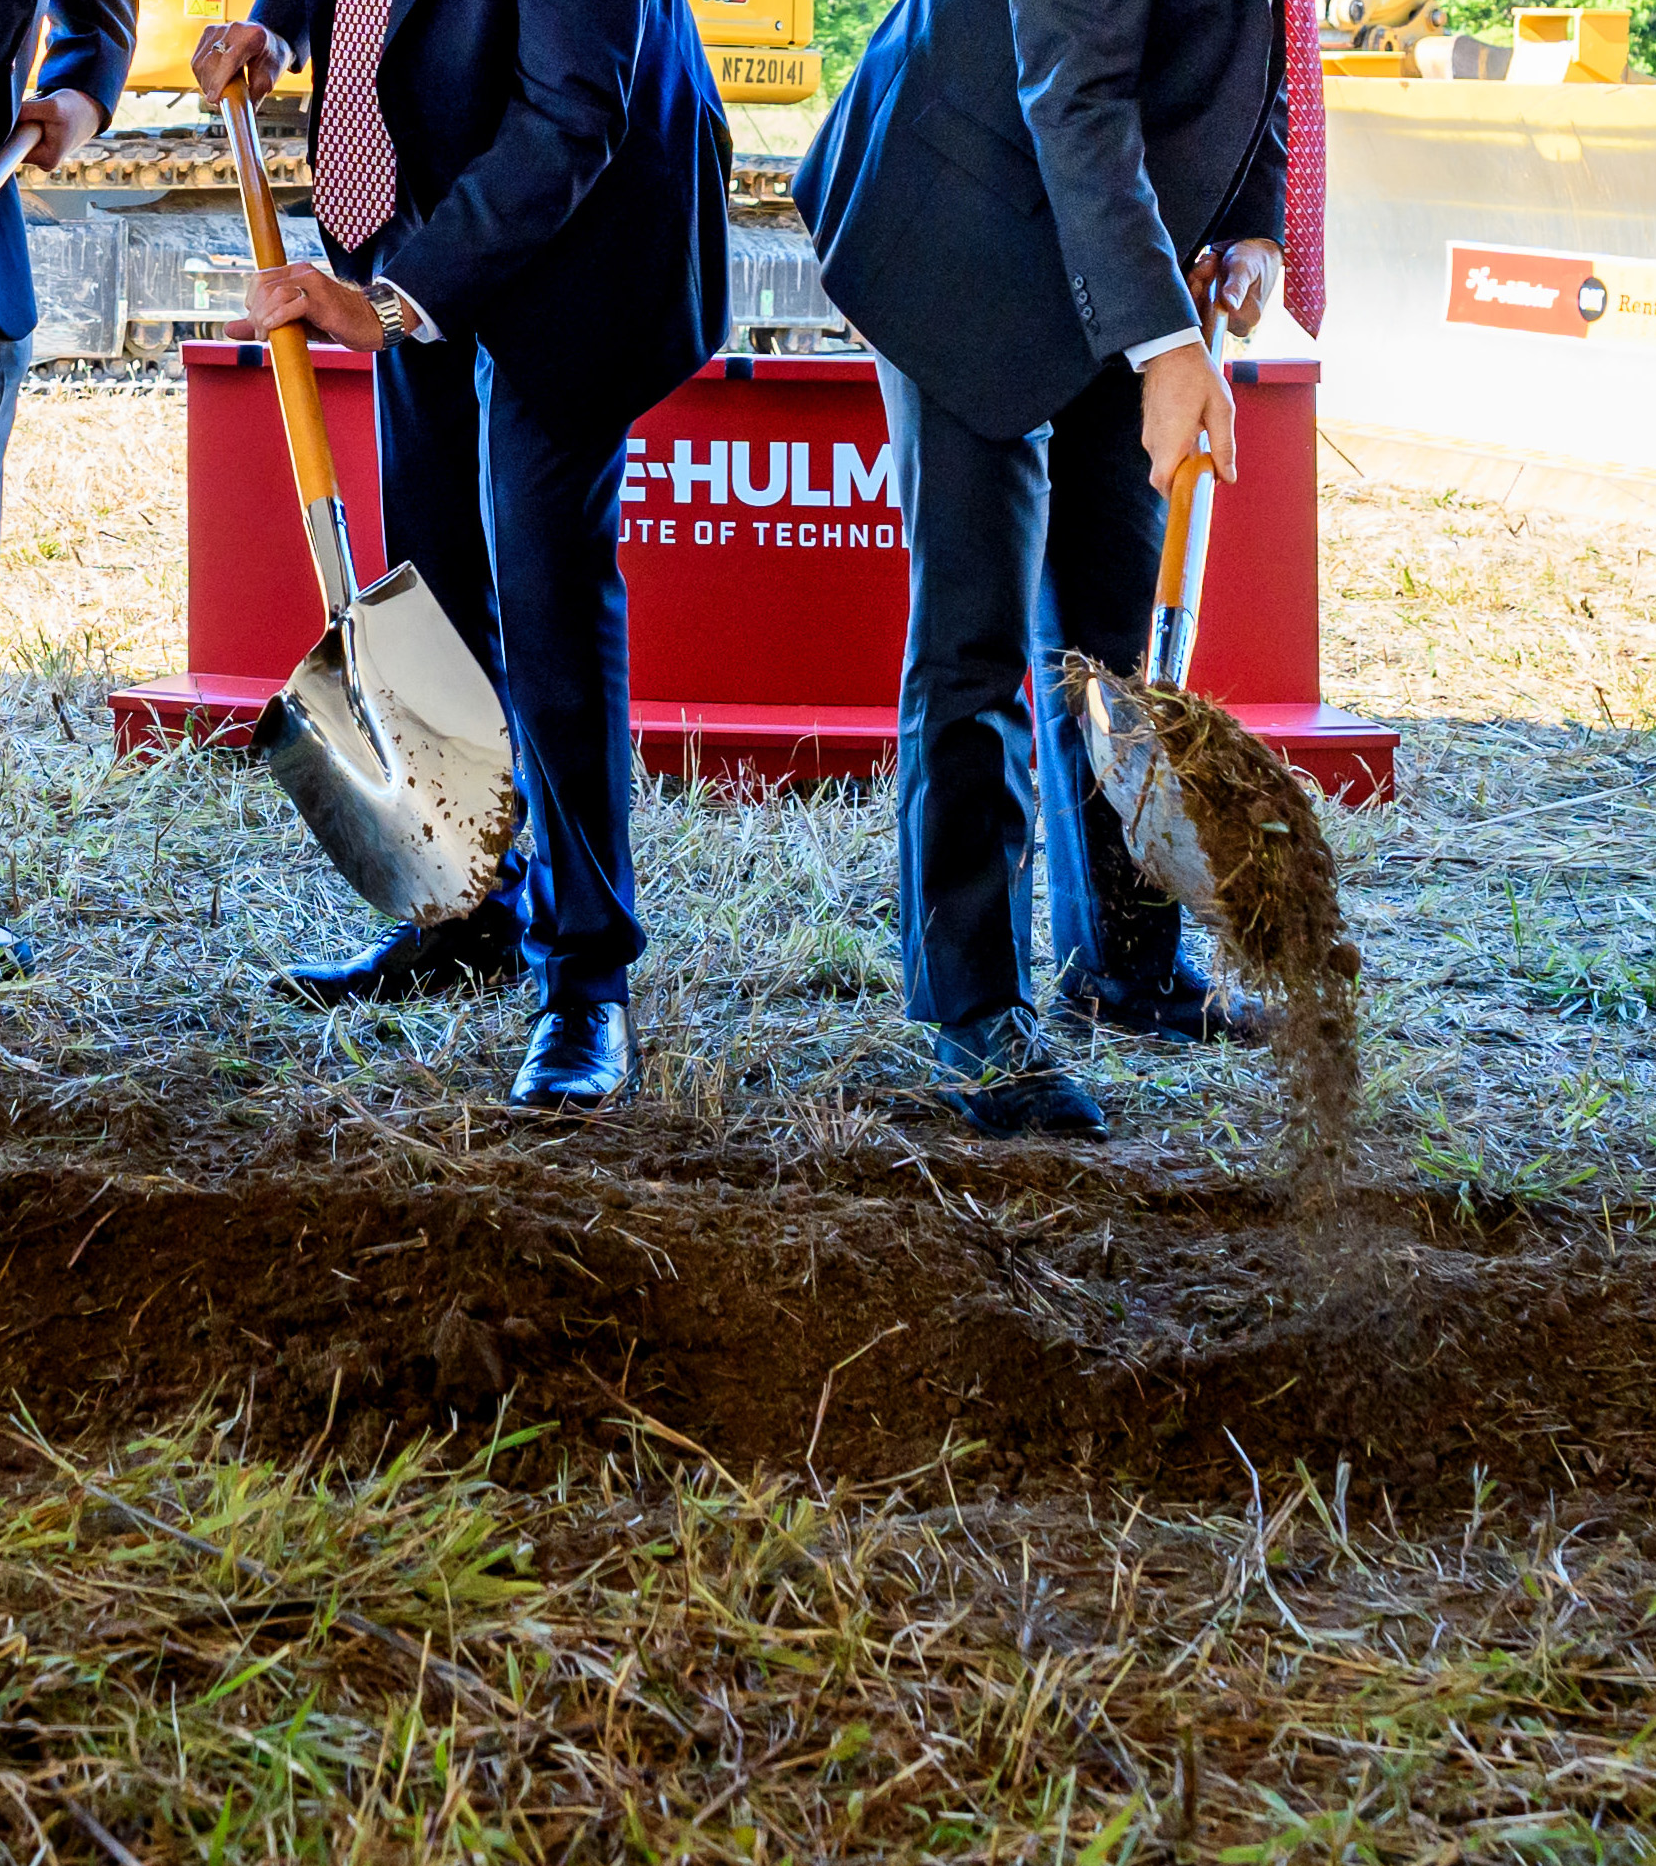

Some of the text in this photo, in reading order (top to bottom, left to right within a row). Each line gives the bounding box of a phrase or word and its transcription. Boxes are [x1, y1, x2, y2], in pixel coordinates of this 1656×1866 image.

[722, 57, 804, 85] NFZ20141
[618, 438, 902, 508] E-HULM
[694, 521, 736, 545] OF
[752, 522, 909, 549] TECHNO
